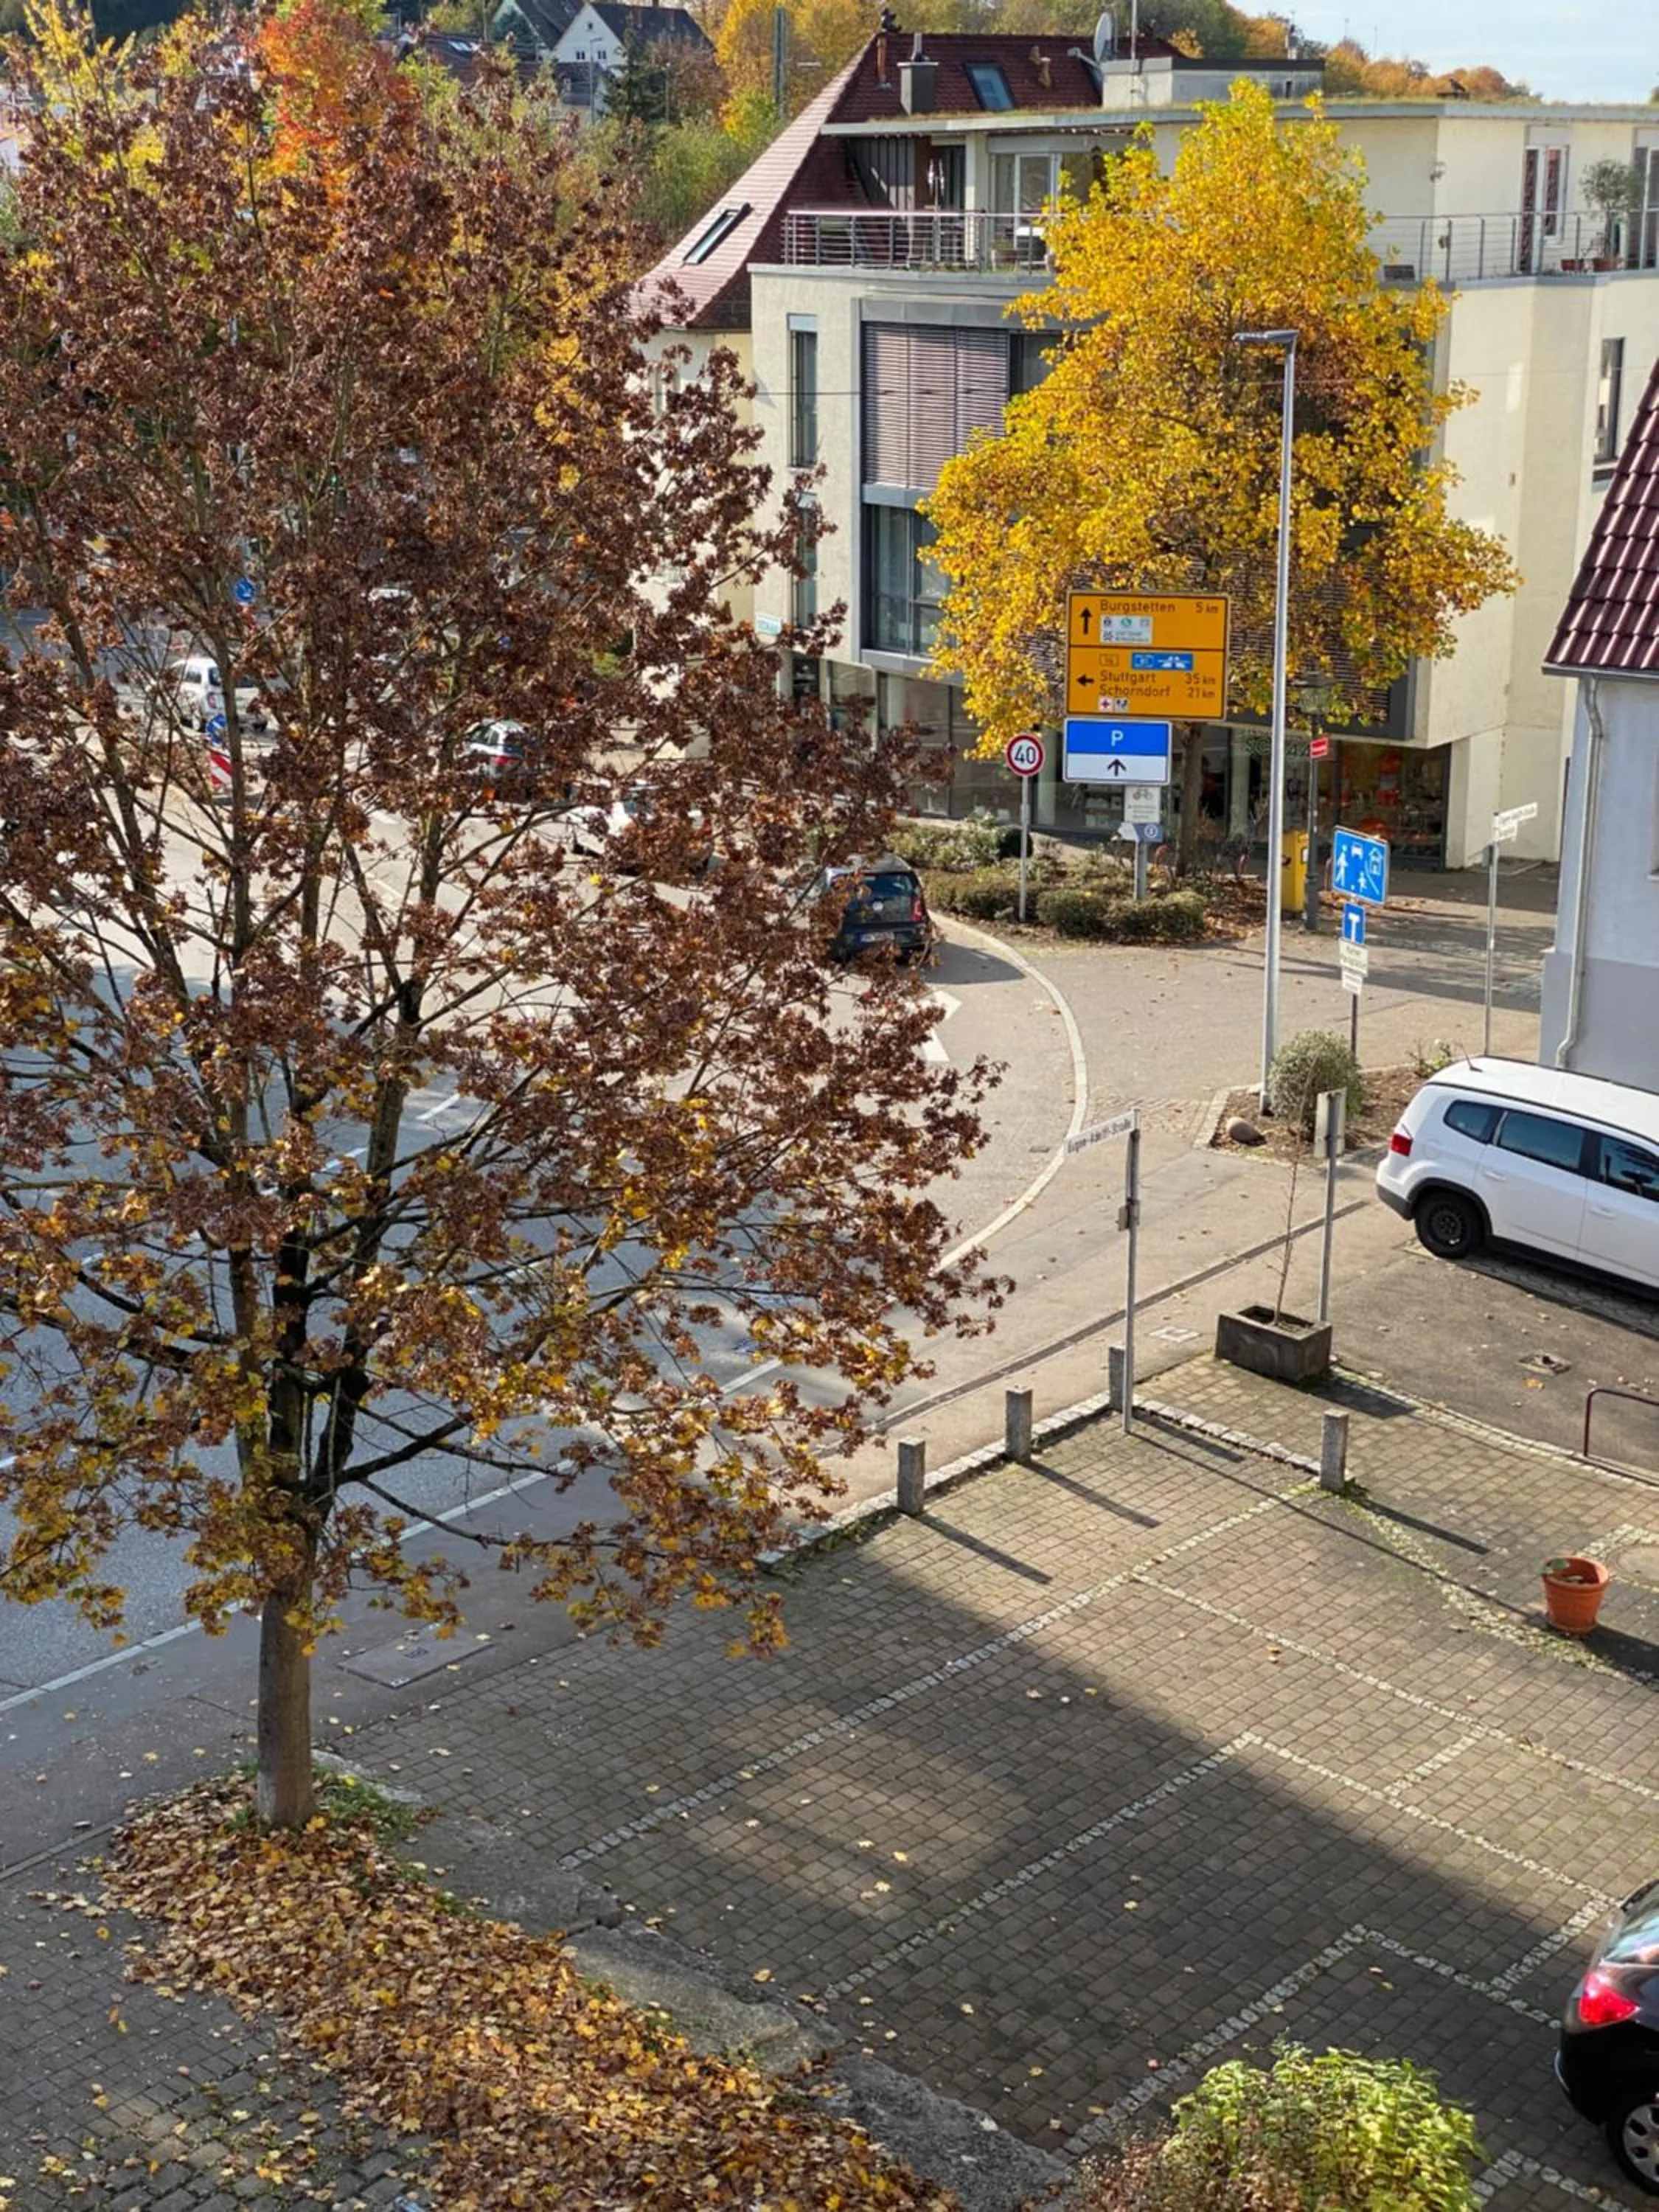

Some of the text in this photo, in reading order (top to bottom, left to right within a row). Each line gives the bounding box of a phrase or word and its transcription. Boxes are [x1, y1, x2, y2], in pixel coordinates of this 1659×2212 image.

[1100, 599, 1218, 613] Burgstetten 5 km
[1099, 669, 1216, 685] Stuttgart 35 km
[1099, 684, 1216, 698] Schorndorf 21 km
[1110, 730, 1124, 747] P
[1015, 745, 1037, 765] 40
